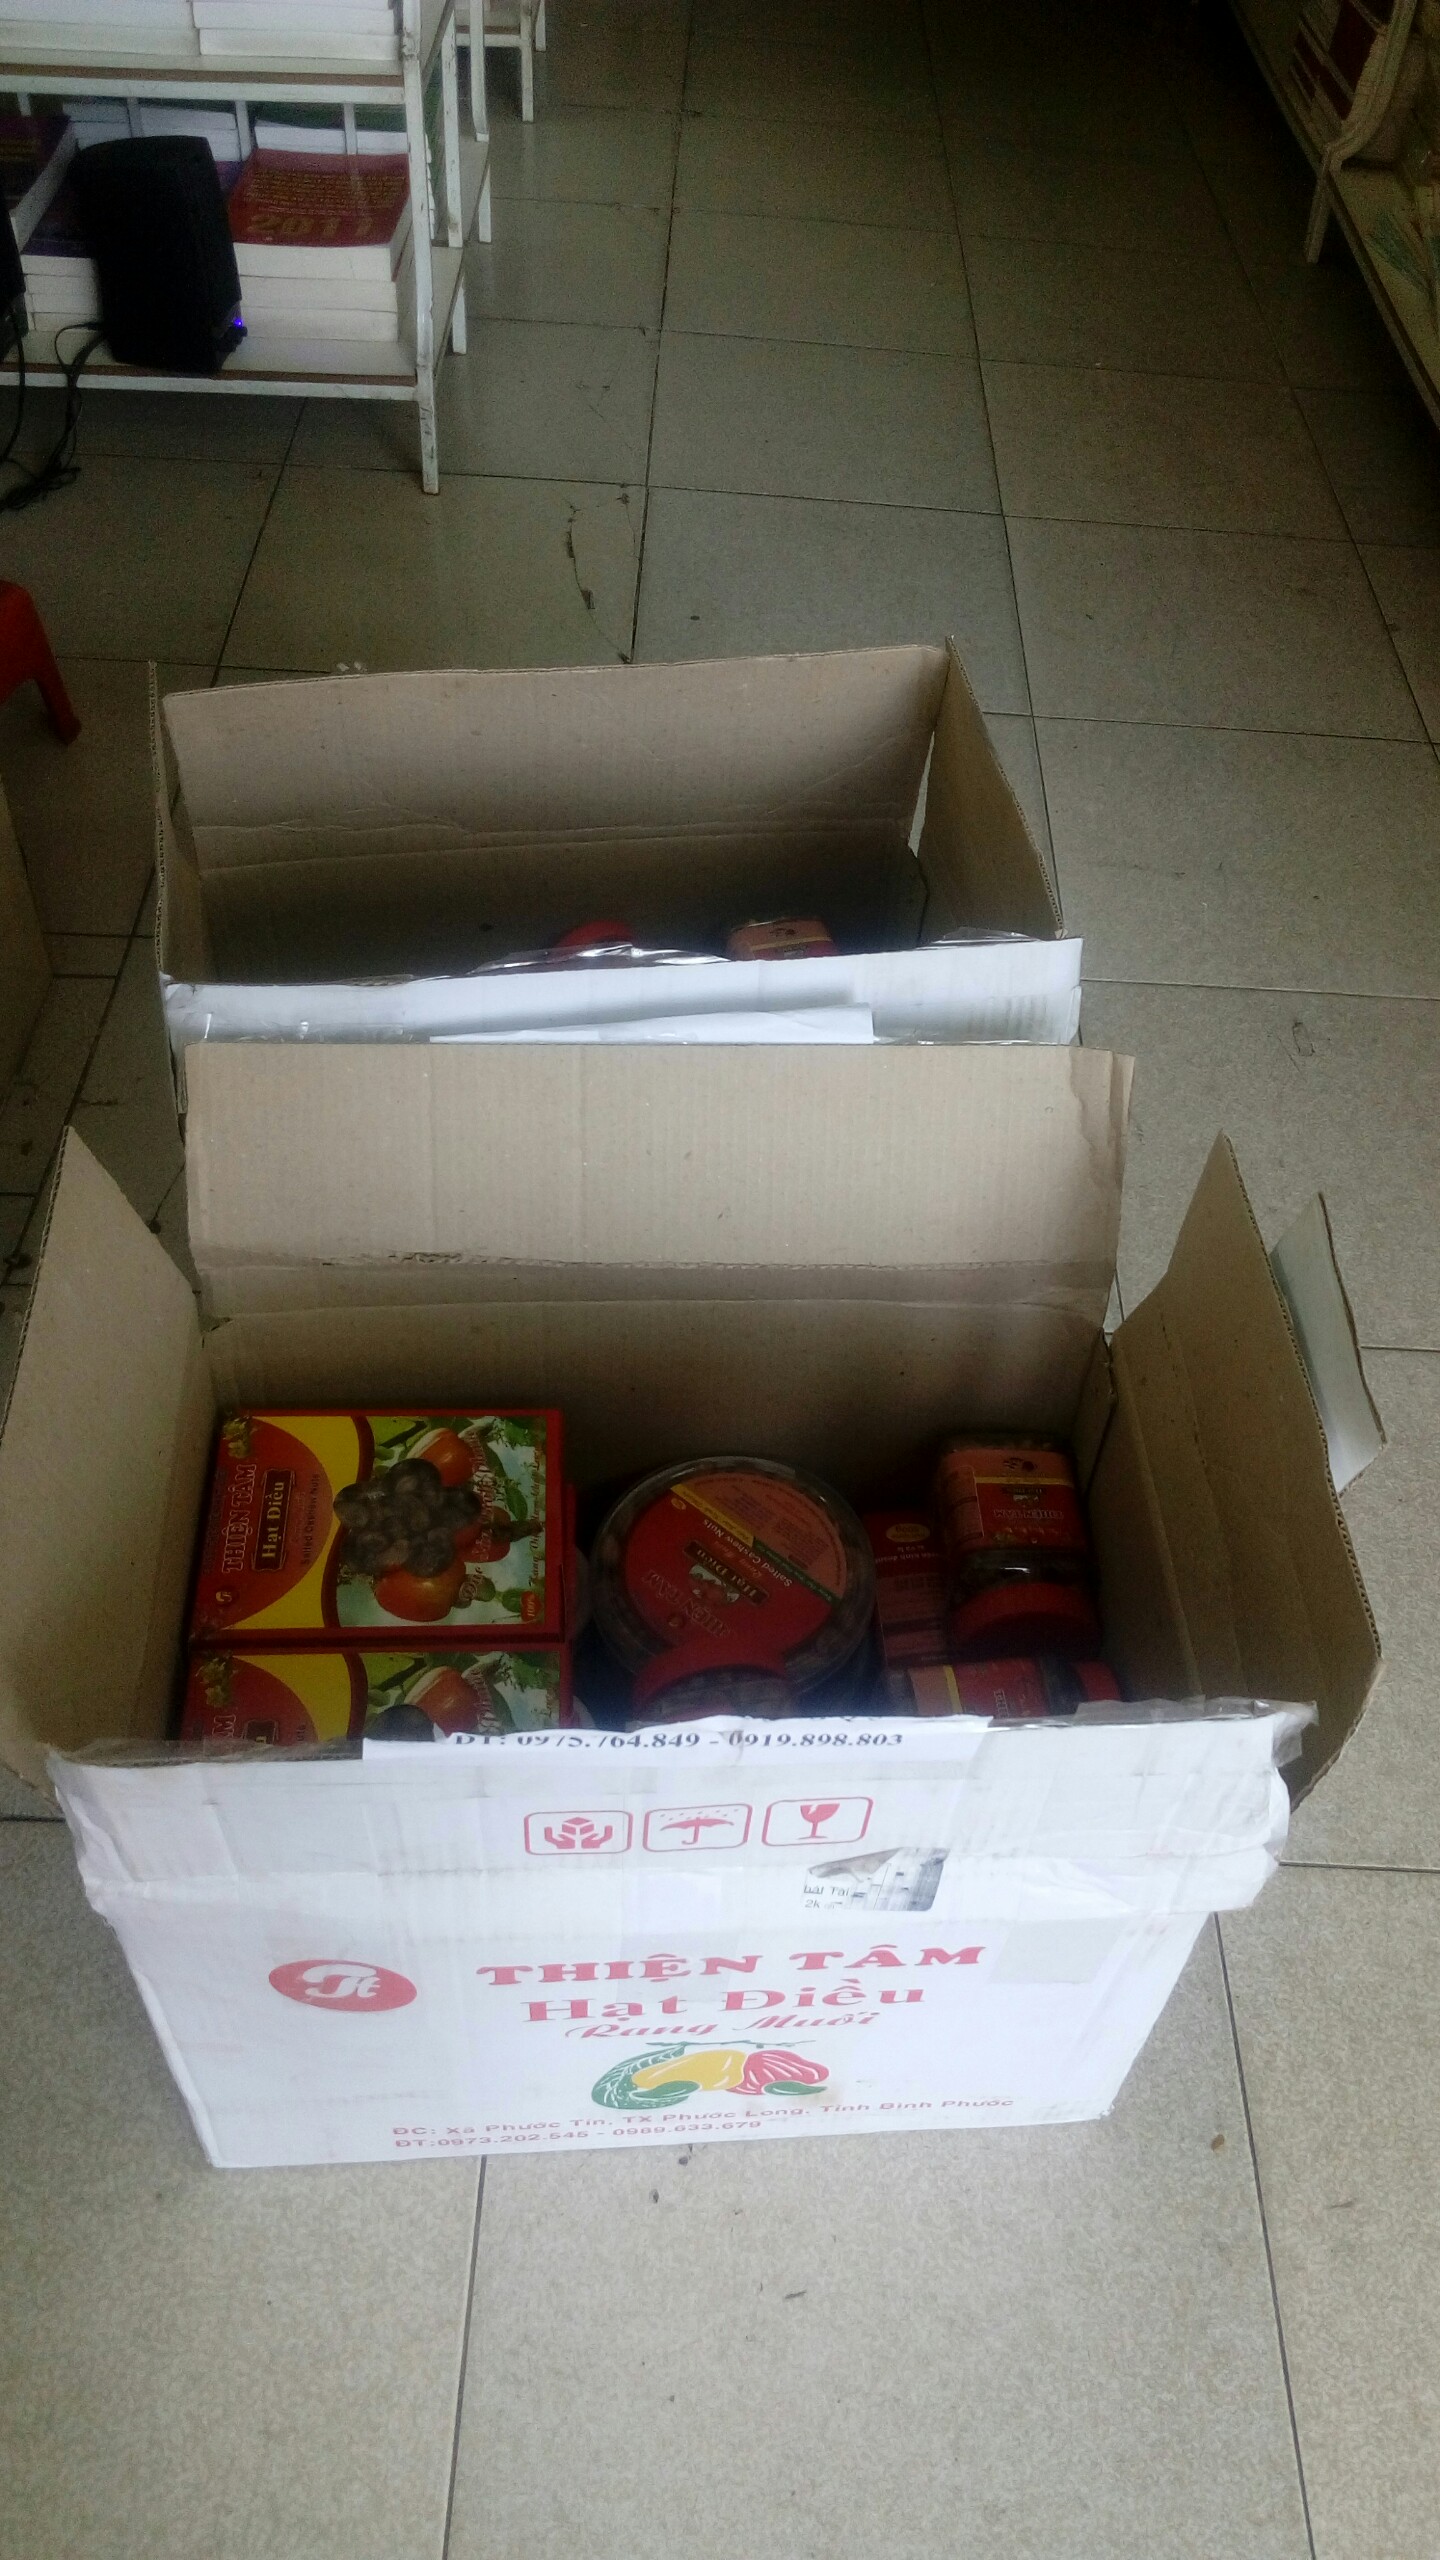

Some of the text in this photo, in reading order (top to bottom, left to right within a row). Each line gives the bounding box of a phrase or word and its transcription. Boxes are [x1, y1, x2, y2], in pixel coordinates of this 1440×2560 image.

[221, 1464, 257, 1574] THIỆN TÂM
[700, 1516, 725, 1539] Nuts
[261, 1526, 282, 1558] Hạt
[723, 1533, 762, 1565] Cashew
[760, 1560, 793, 1587] Salted
[728, 1731, 904, 1748] 0919.898.803
[476, 1944, 987, 1986] THIỆN TÂM
[519, 1978, 925, 2022] Hạt Điều
[564, 2011, 881, 2038] Rang Muối
[485, 2120, 561, 2133] Phước
[622, 2114, 653, 2124] TX
[662, 2109, 737, 2123] Phước
[940, 2097, 1014, 2109] Phước
[612, 2120, 762, 2137] 0989.633.679
